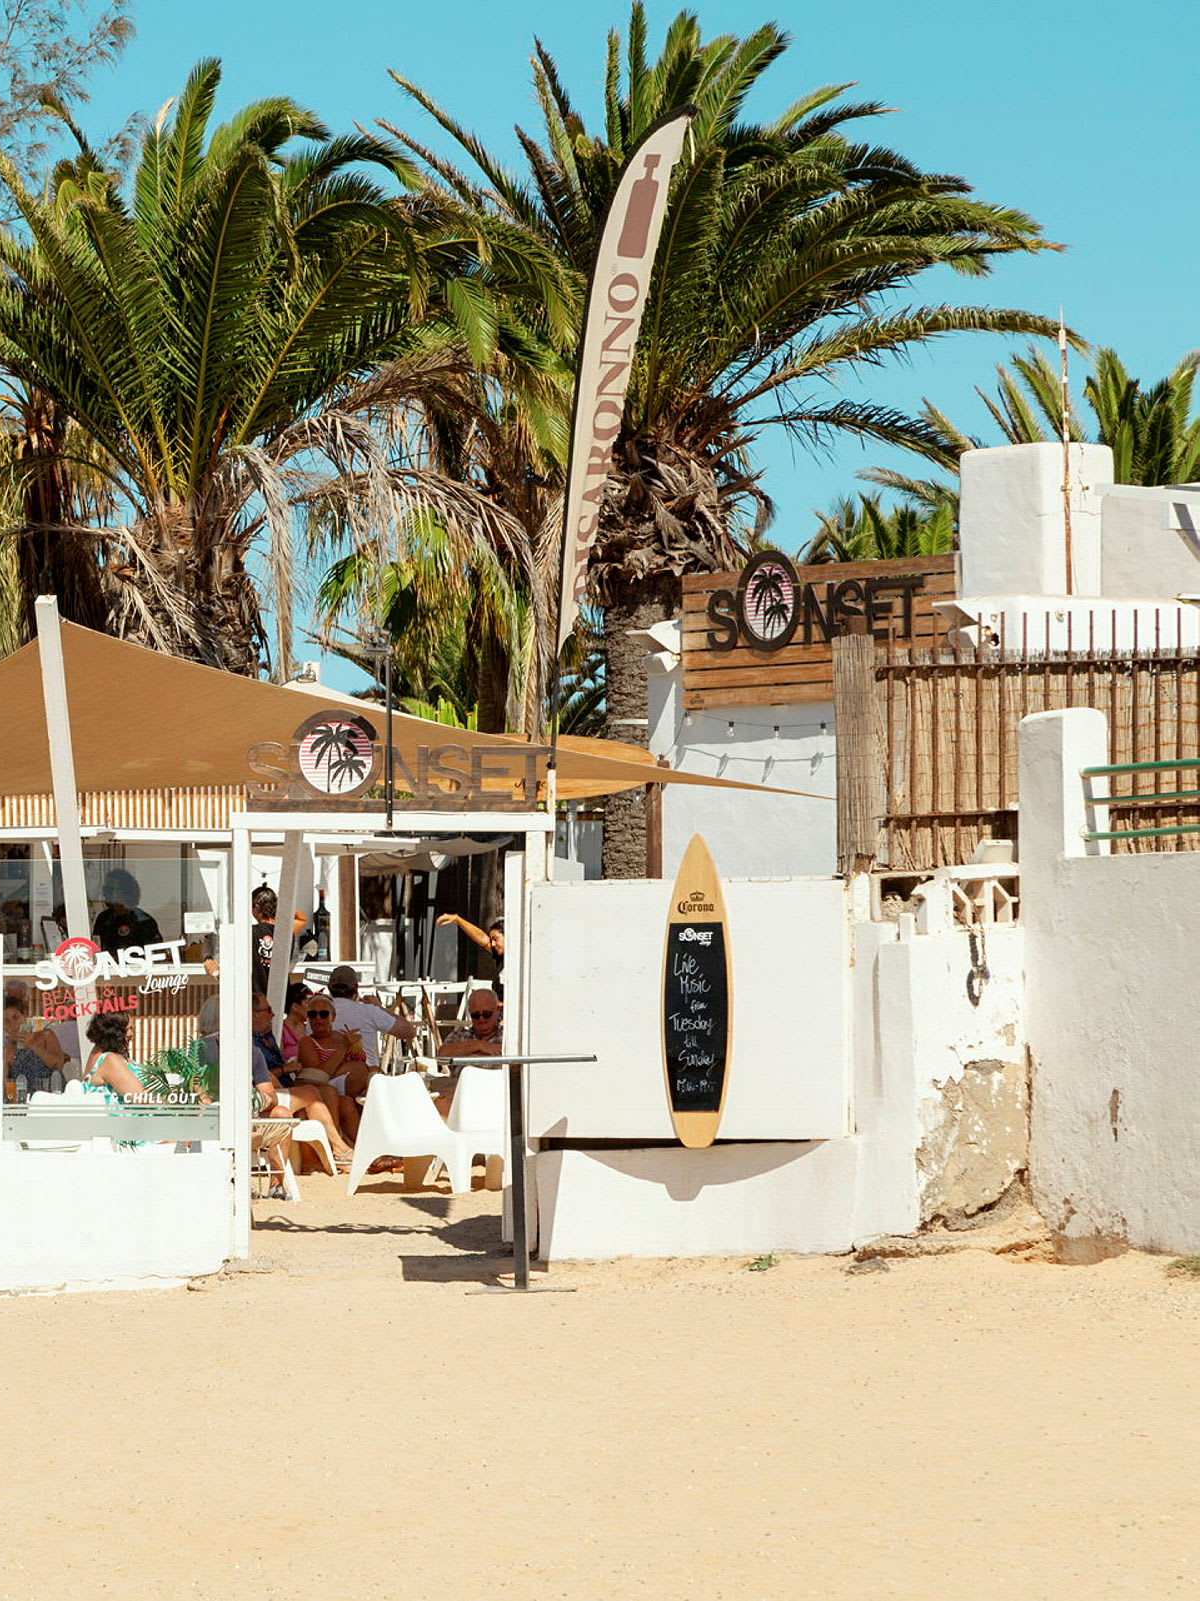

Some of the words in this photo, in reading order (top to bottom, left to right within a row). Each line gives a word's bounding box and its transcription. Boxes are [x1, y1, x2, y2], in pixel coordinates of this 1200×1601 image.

[677, 900, 715, 915] Corona
[674, 952, 699, 976] Live
[42, 988, 96, 1007] BEACH
[102, 982, 115, 998] &
[138, 974, 189, 995] Lounge
[680, 973, 711, 996] Music
[43, 995, 138, 1021] COCKTAILS
[668, 1012, 712, 1035] Tuesday
[123, 1092, 163, 1104] CHILL
[167, 1092, 198, 1104] OUT
